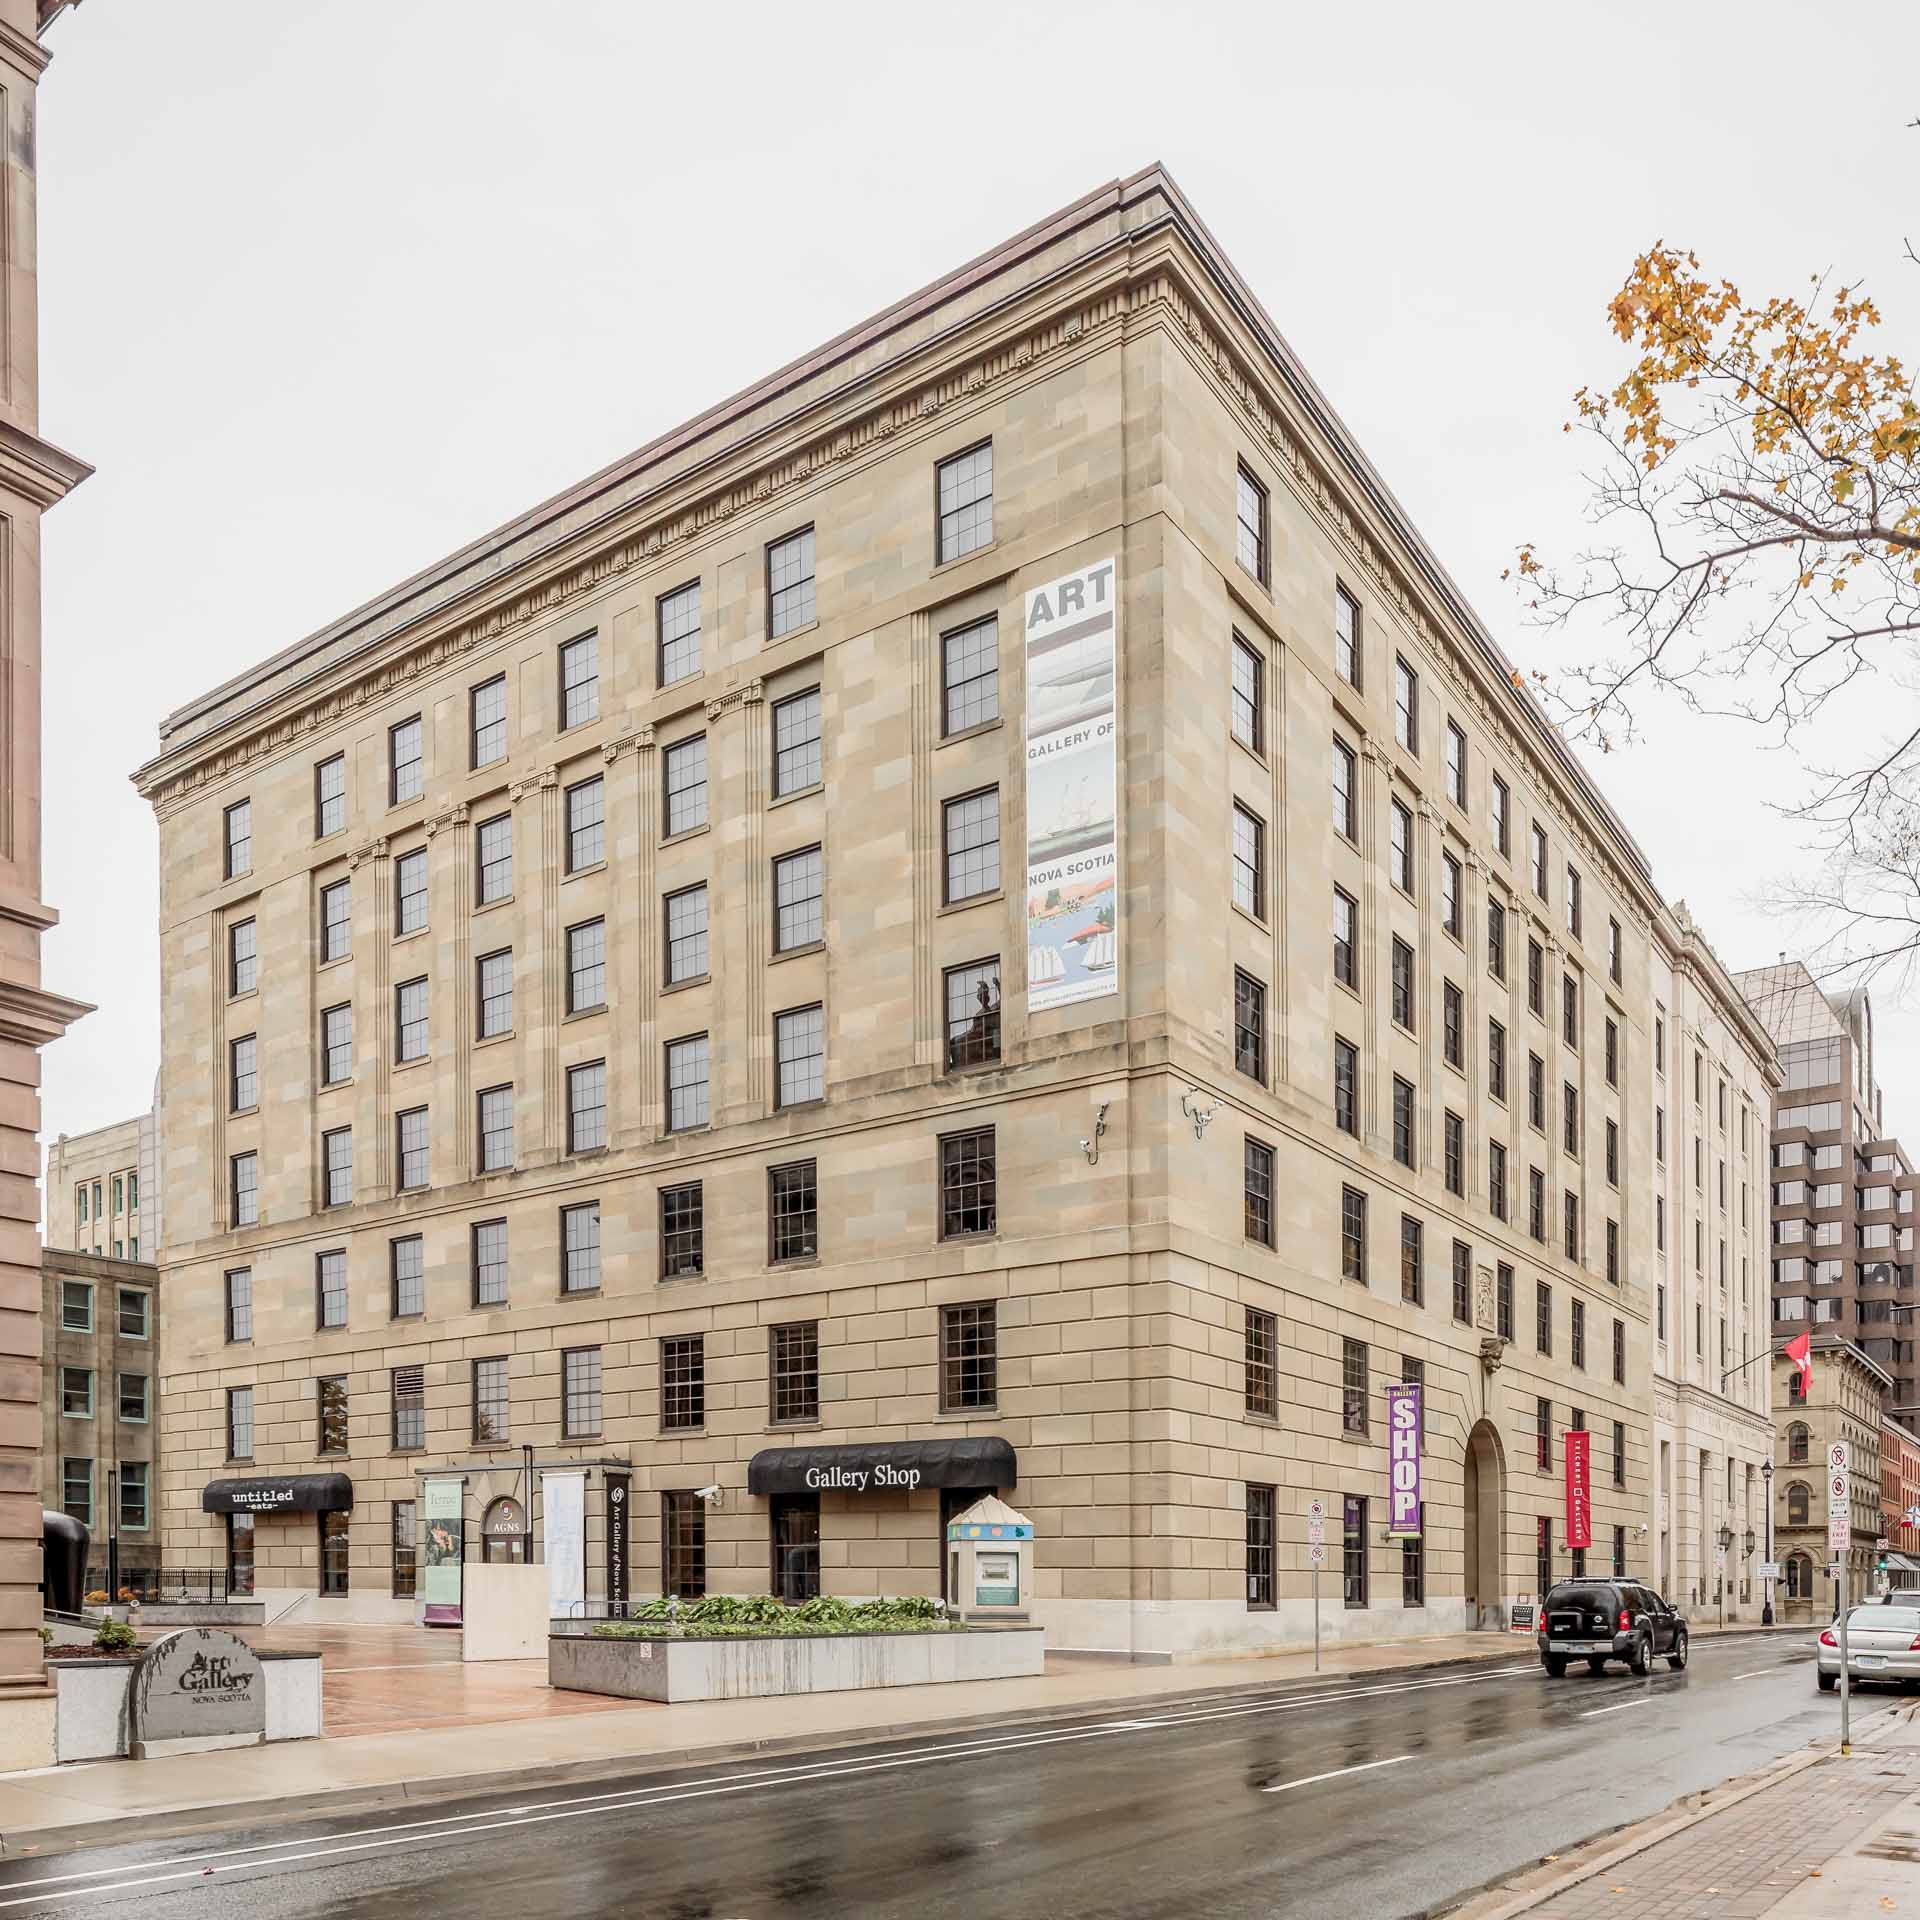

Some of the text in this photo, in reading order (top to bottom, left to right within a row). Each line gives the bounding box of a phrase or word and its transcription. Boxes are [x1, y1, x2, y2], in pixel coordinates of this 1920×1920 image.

[1027, 565, 1113, 629] ART
[1028, 721, 1114, 759] GALLERY OF
[1029, 853, 1115, 888] NOVA SCOTIA
[1393, 1398, 1417, 1520] SHOP
[805, 1464, 920, 1491] Gallery Shop
[232, 1489, 294, 1502] untitled
[613, 1506, 621, 1520] Art
[494, 1522, 520, 1532] AGNS
[612, 1522, 621, 1553] Gallery
[613, 1563, 621, 1586] Nova
[191, 1650, 230, 1671] Art
[179, 1667, 254, 1691] Gallery
[192, 1693, 253, 1704] NOVA SCOTIA
